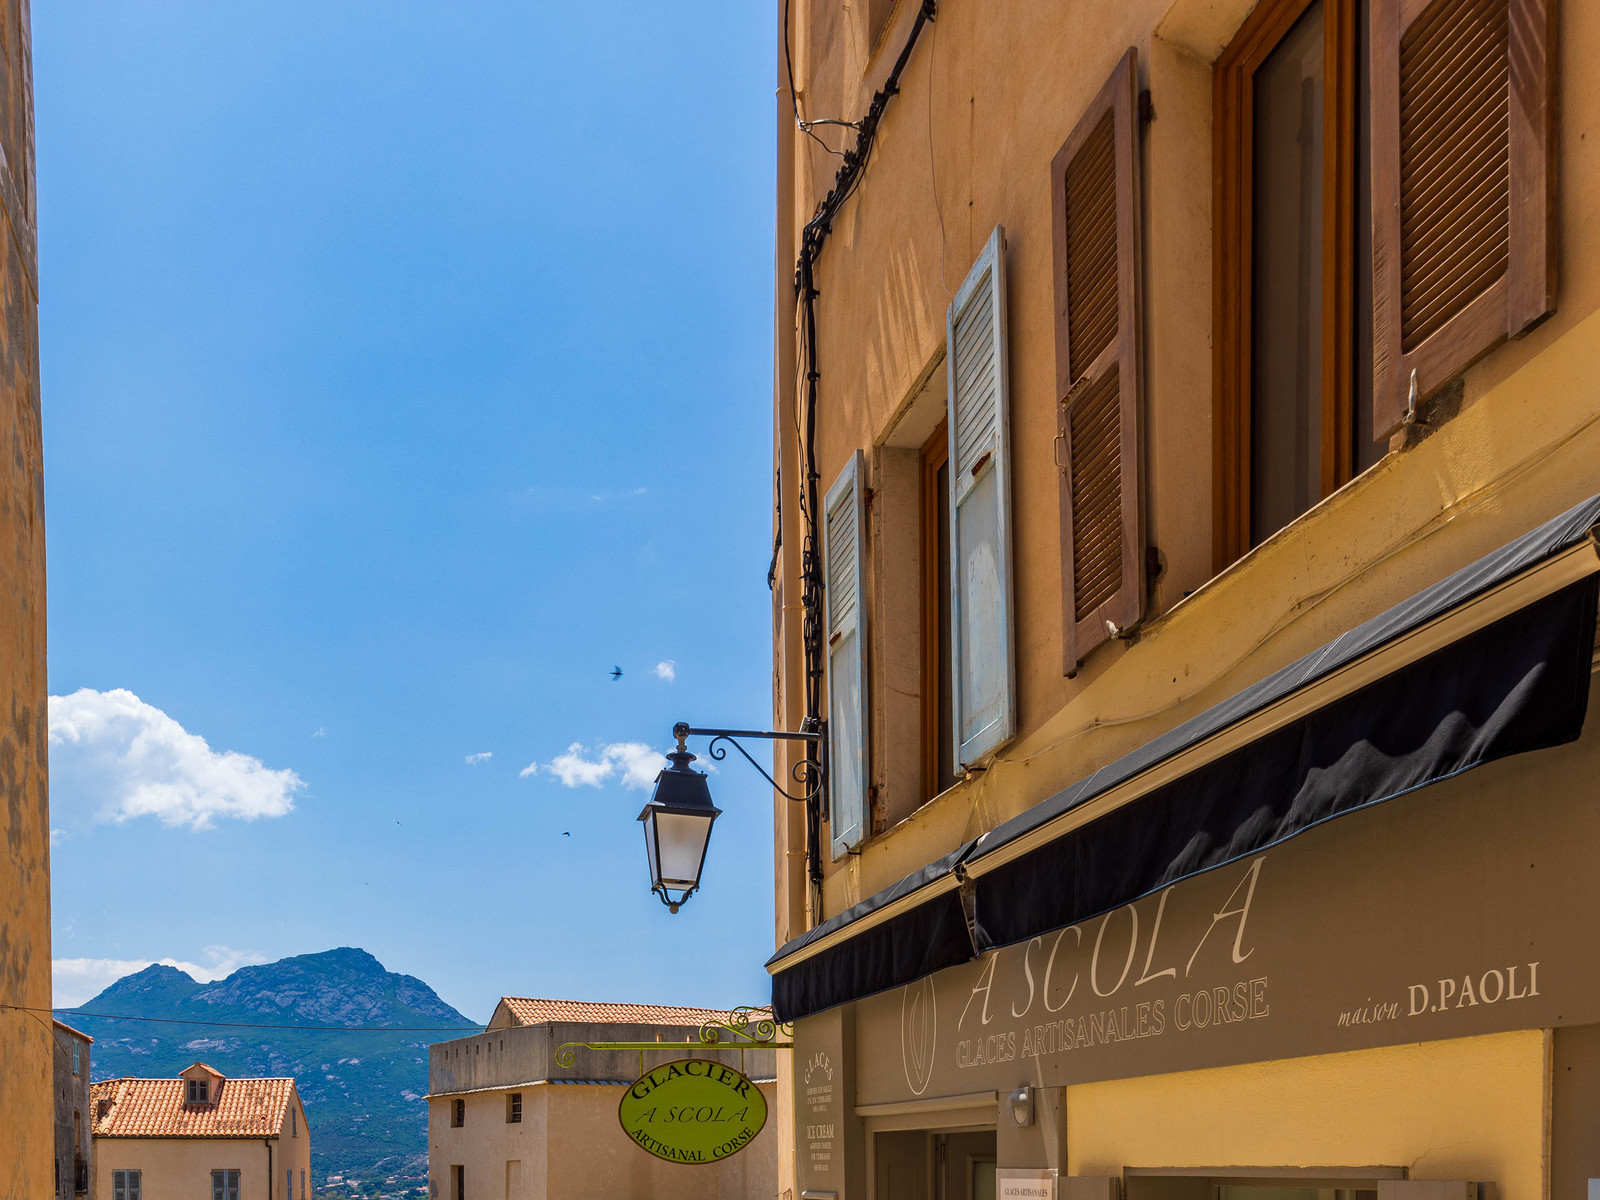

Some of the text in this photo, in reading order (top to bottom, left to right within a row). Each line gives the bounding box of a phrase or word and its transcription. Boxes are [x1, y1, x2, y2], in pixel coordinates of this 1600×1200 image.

[957, 856, 1266, 1032] A SCOLA
[1337, 962, 1540, 1027] maison D.PAOLI
[955, 976, 1270, 1069] GLACES ARTISANALES CORSE
[631, 1061, 750, 1100] GLACIER
[804, 1052, 834, 1085] GLACES
[635, 1106, 749, 1123] A SCOLA
[816, 1124, 835, 1139] CREAM
[631, 1126, 755, 1161] ARTISANAL CORSE
[1004, 1187, 1048, 1198] GLACES ARTISANALES
